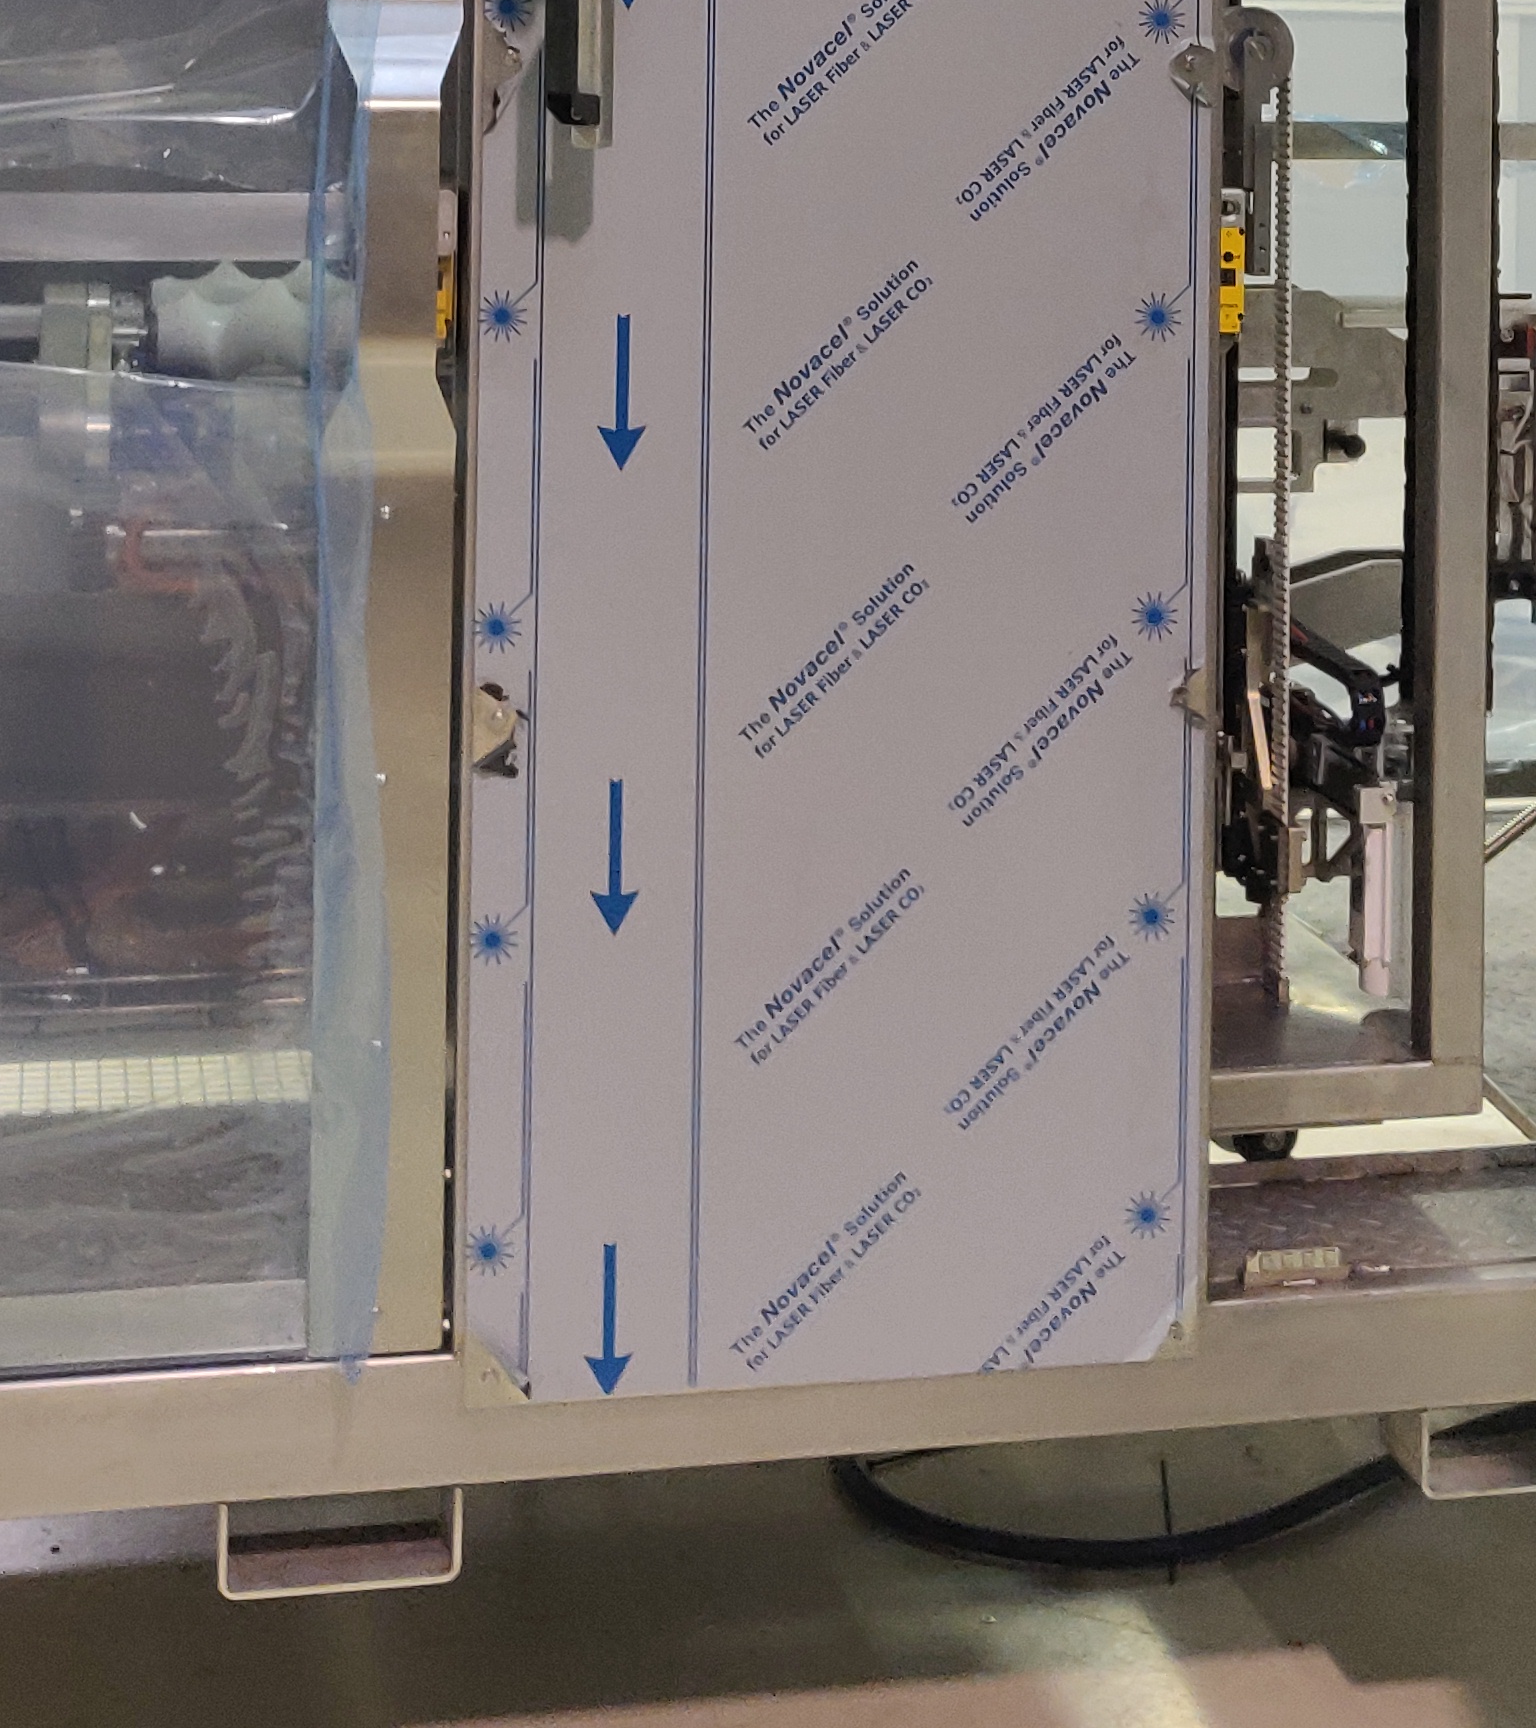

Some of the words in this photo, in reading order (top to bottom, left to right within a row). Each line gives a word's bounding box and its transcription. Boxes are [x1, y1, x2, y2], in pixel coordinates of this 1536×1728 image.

[1104, 35, 1125, 59] for
[1109, 53, 1141, 80] The
[763, 123, 785, 146] for
[783, 81, 829, 126] LASER
[825, 48, 860, 84] Fiber
[1061, 55, 1106, 99] LASER
[747, 101, 780, 128] The
[1031, 96, 1065, 132] Fiber
[979, 138, 1025, 182] LASER
[969, 161, 1031, 221] Solution
[742, 404, 775, 433] The
[856, 260, 919, 321] Solution
[1101, 333, 1122, 357] for
[1105, 351, 1137, 378] The
[758, 427, 781, 451] for
[779, 385, 825, 430] LASER
[821, 351, 857, 388] Fiber
[863, 299, 909, 344] LASER
[1058, 353, 1102, 398] LASER
[1027, 396, 1062, 432] Fiber
[975, 438, 1020, 484] LASER
[965, 462, 1027, 523] Solution
[738, 713, 771, 741] The
[851, 564, 915, 626] Solution
[1097, 634, 1118, 657] for
[1102, 652, 1133, 679] The
[754, 735, 776, 759] for
[774, 691, 820, 737] LASER
[815, 656, 852, 694] Fiber
[858, 604, 905, 649] LASER
[1055, 655, 1099, 699] LASER
[1023, 697, 1059, 734] Fiber
[972, 741, 1017, 787] LASER
[962, 765, 1024, 827] Solution
[771, 999, 815, 1044] LASER
[855, 909, 901, 955] LASER
[1052, 956, 1095, 1002] LASER
[1099, 952, 1130, 980] The
[734, 1020, 767, 1048] The
[969, 1045, 1013, 1090] LASER
[767, 1303, 812, 1349] LASER
[851, 1213, 896, 1259] LASER
[1047, 1256, 1092, 1302] LASER
[1095, 1251, 1126, 1278] The
[729, 1326, 763, 1353] The
